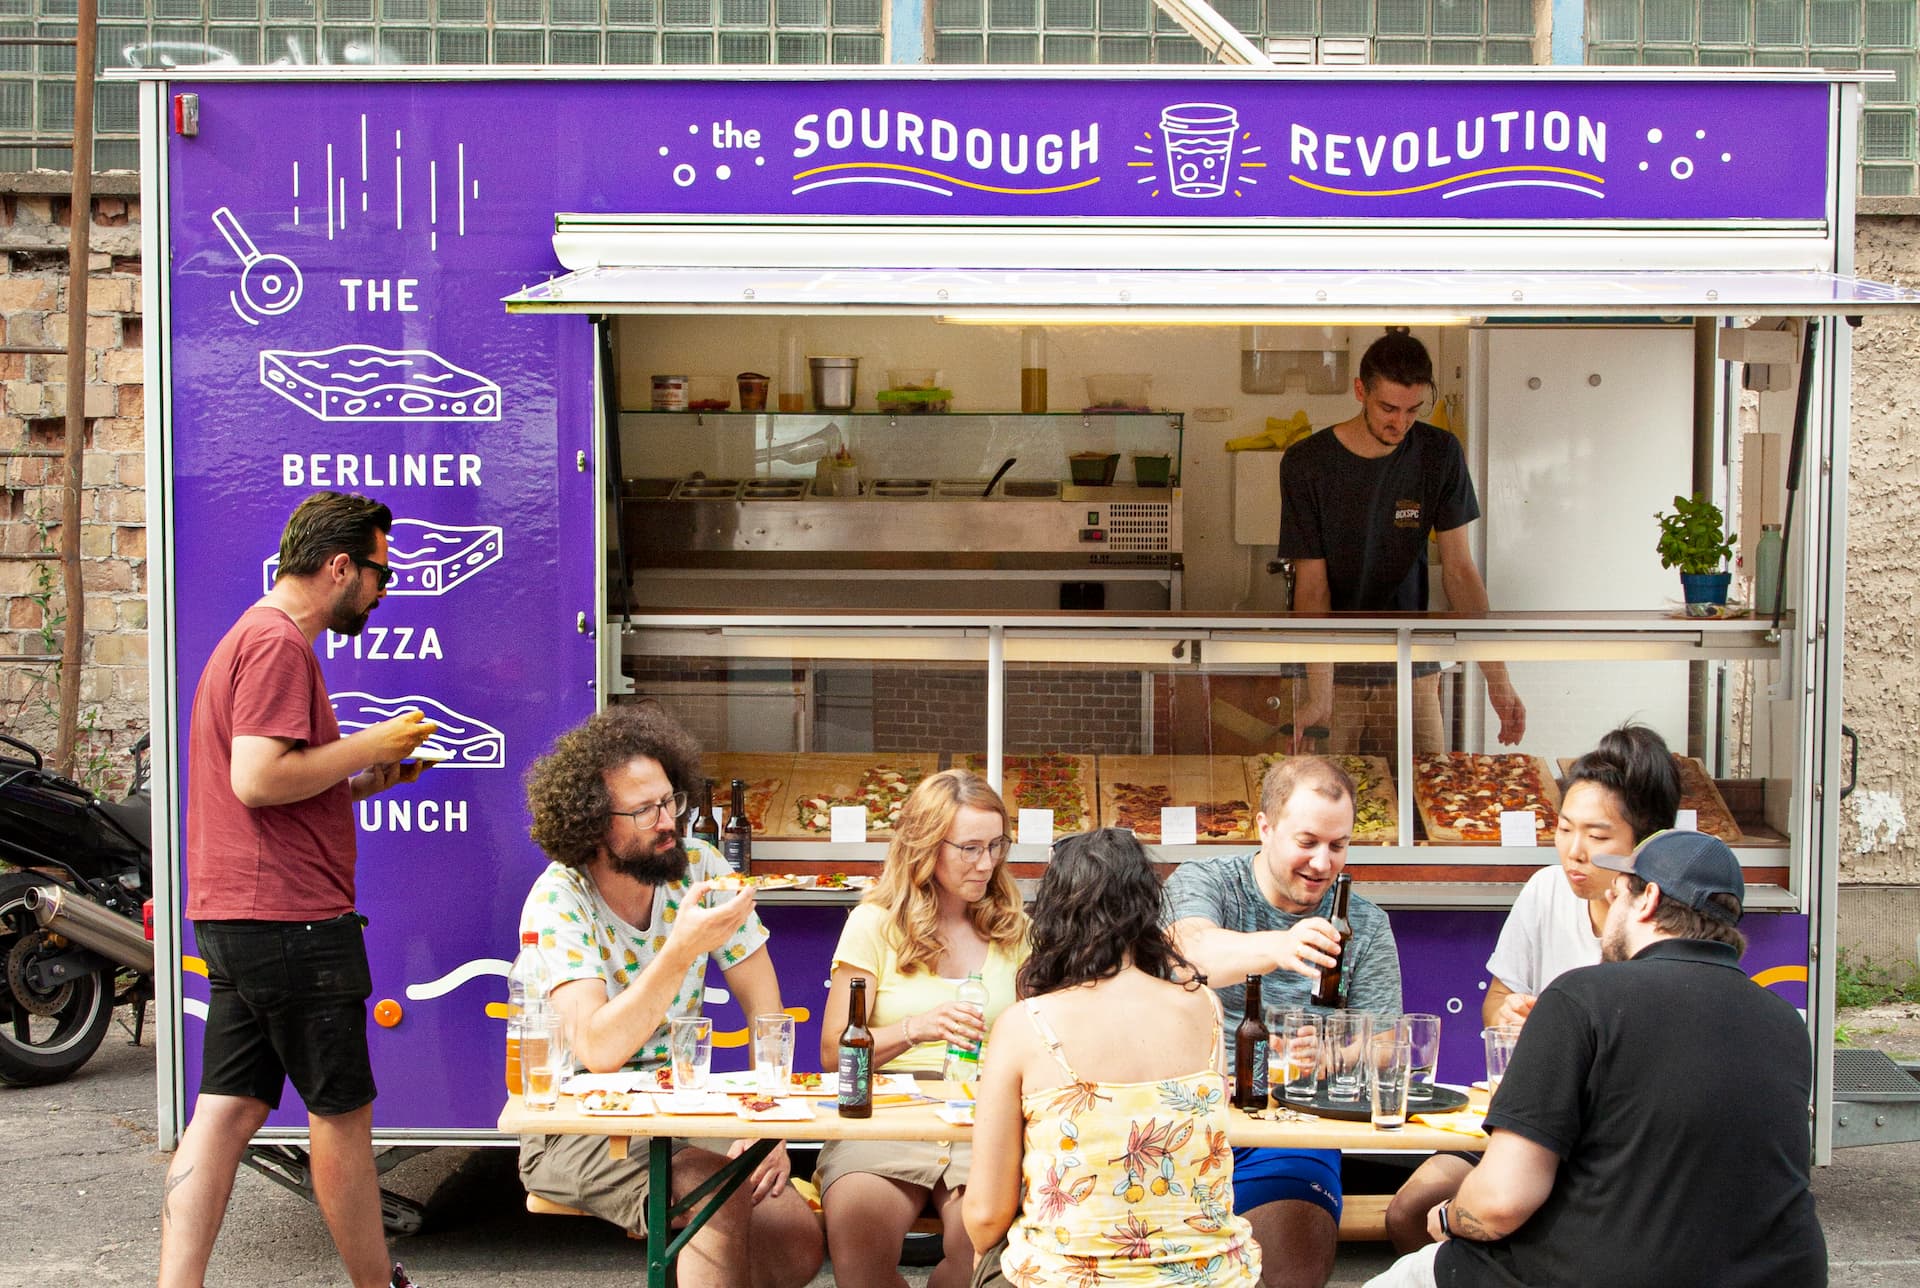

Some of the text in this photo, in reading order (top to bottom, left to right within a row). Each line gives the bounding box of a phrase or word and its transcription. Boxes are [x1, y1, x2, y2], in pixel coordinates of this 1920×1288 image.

[712, 107, 1608, 177] the SOURDOUGH REVOLUTION
[339, 278, 420, 312] THE
[282, 453, 483, 487] BERLINER
[326, 627, 444, 660] PIZZA
[359, 799, 468, 833] UNCH
